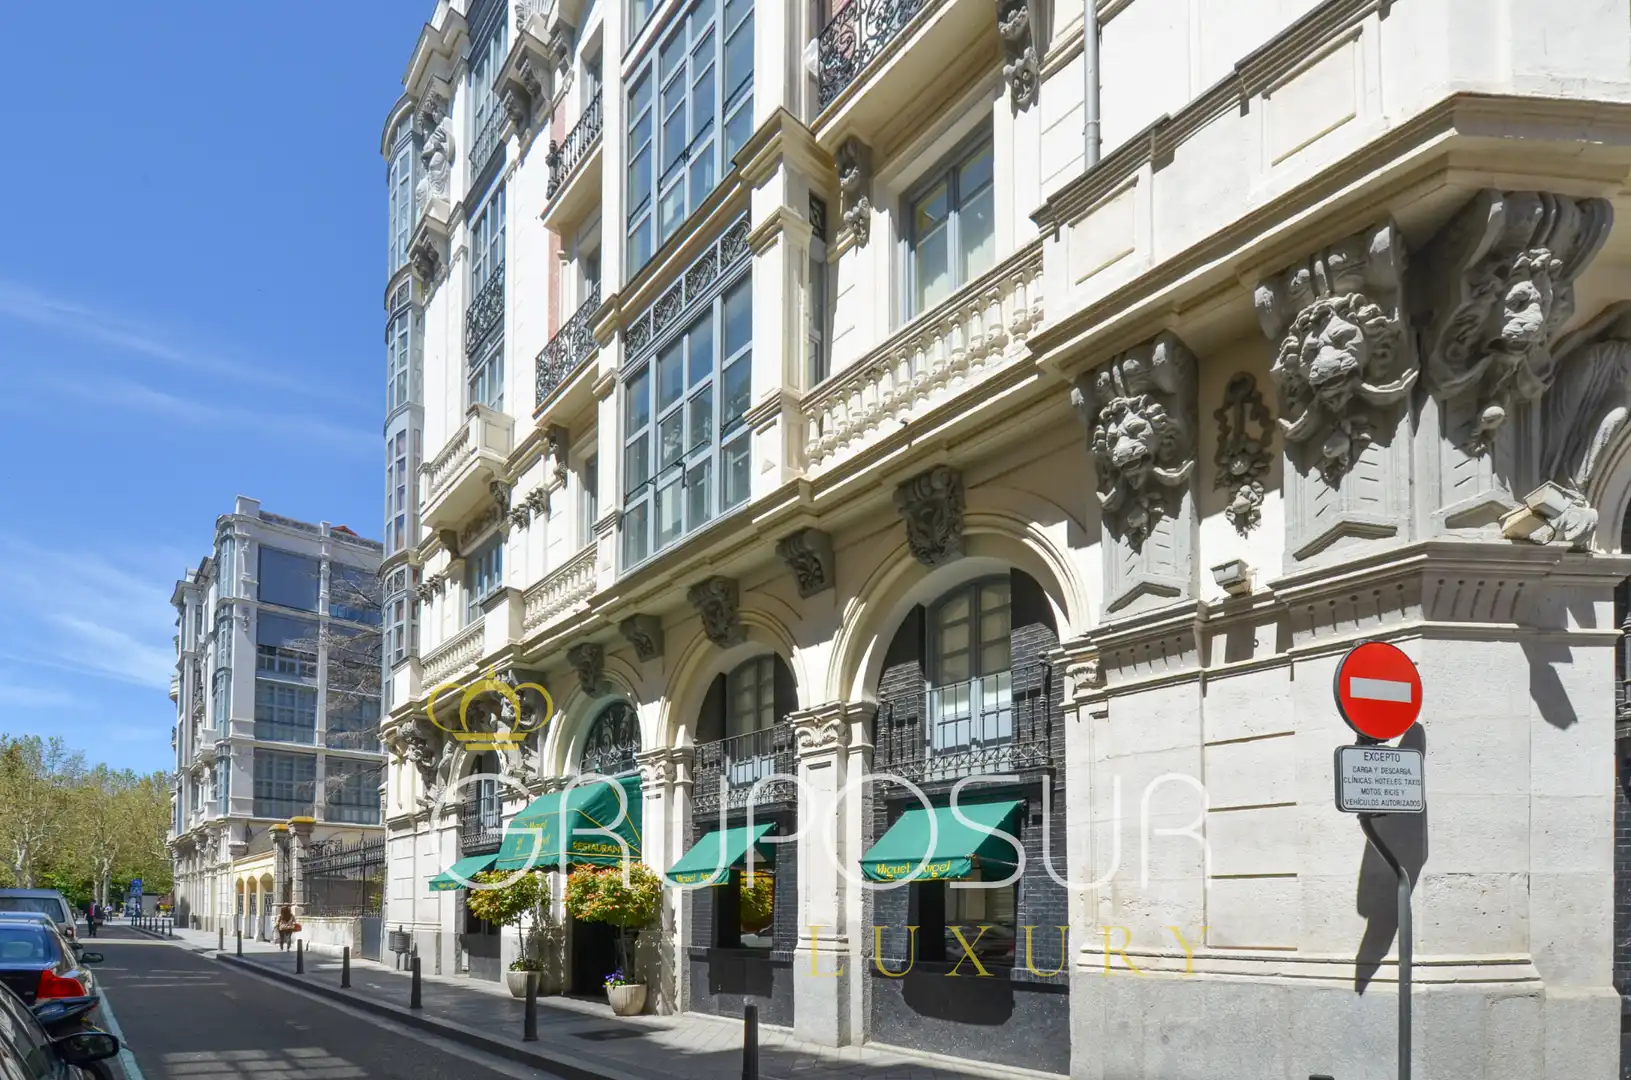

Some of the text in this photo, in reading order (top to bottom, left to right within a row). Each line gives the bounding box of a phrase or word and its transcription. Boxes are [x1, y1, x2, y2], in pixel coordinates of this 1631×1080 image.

[1364, 752, 1401, 762] EXCEPTO
[1352, 766, 1372, 774] CARGA
[1344, 798, 1379, 806] VEHÍCULOS
[876, 862, 911, 878] Miguel
